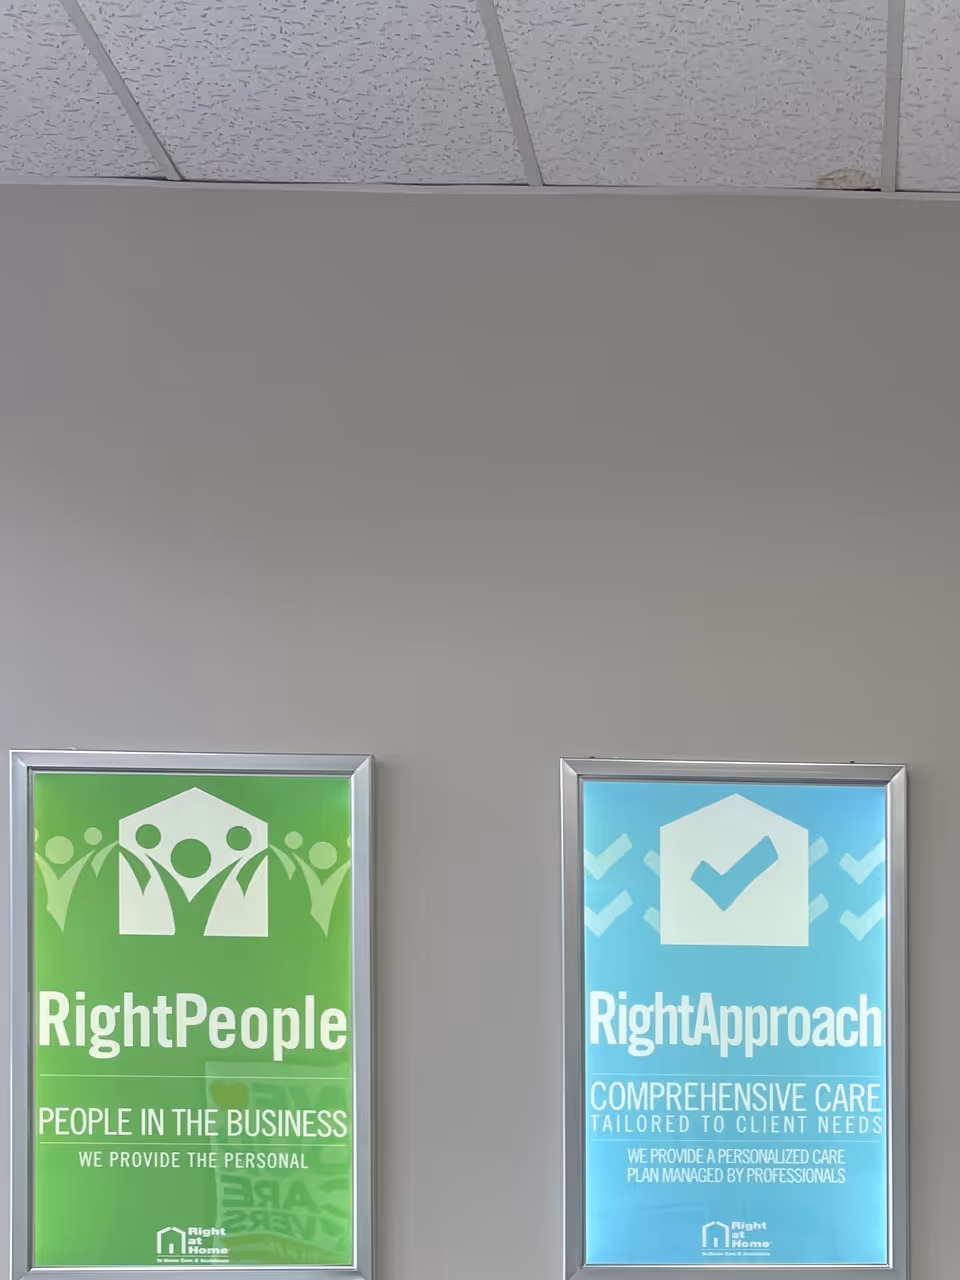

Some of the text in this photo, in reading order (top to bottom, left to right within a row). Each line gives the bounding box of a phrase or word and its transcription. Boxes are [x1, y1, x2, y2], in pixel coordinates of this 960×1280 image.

[39, 990, 348, 1061] RightPeople
[589, 990, 882, 1058] RightApproach
[590, 1081, 882, 1113] COMPREHENSIVE CARE
[39, 1107, 348, 1137] PEOPLE IN THE BUSINESS
[590, 1114, 883, 1134] TAILORED TO CLIENT NEEDS
[78, 1151, 309, 1169] WE PROVIDE THE PERSONAL
[627, 1148, 846, 1165] WE PROVIDE A PERSONALIZED CARE
[627, 1167, 846, 1184] PLAN MANAGED BY PROFESSIONALS
[187, 1227, 226, 1237] Right
[731, 1221, 767, 1231] Right
[187, 1237, 202, 1245] at
[731, 1231, 745, 1239] at
[188, 1246, 229, 1254] Home
[731, 1240, 770, 1248] Home
